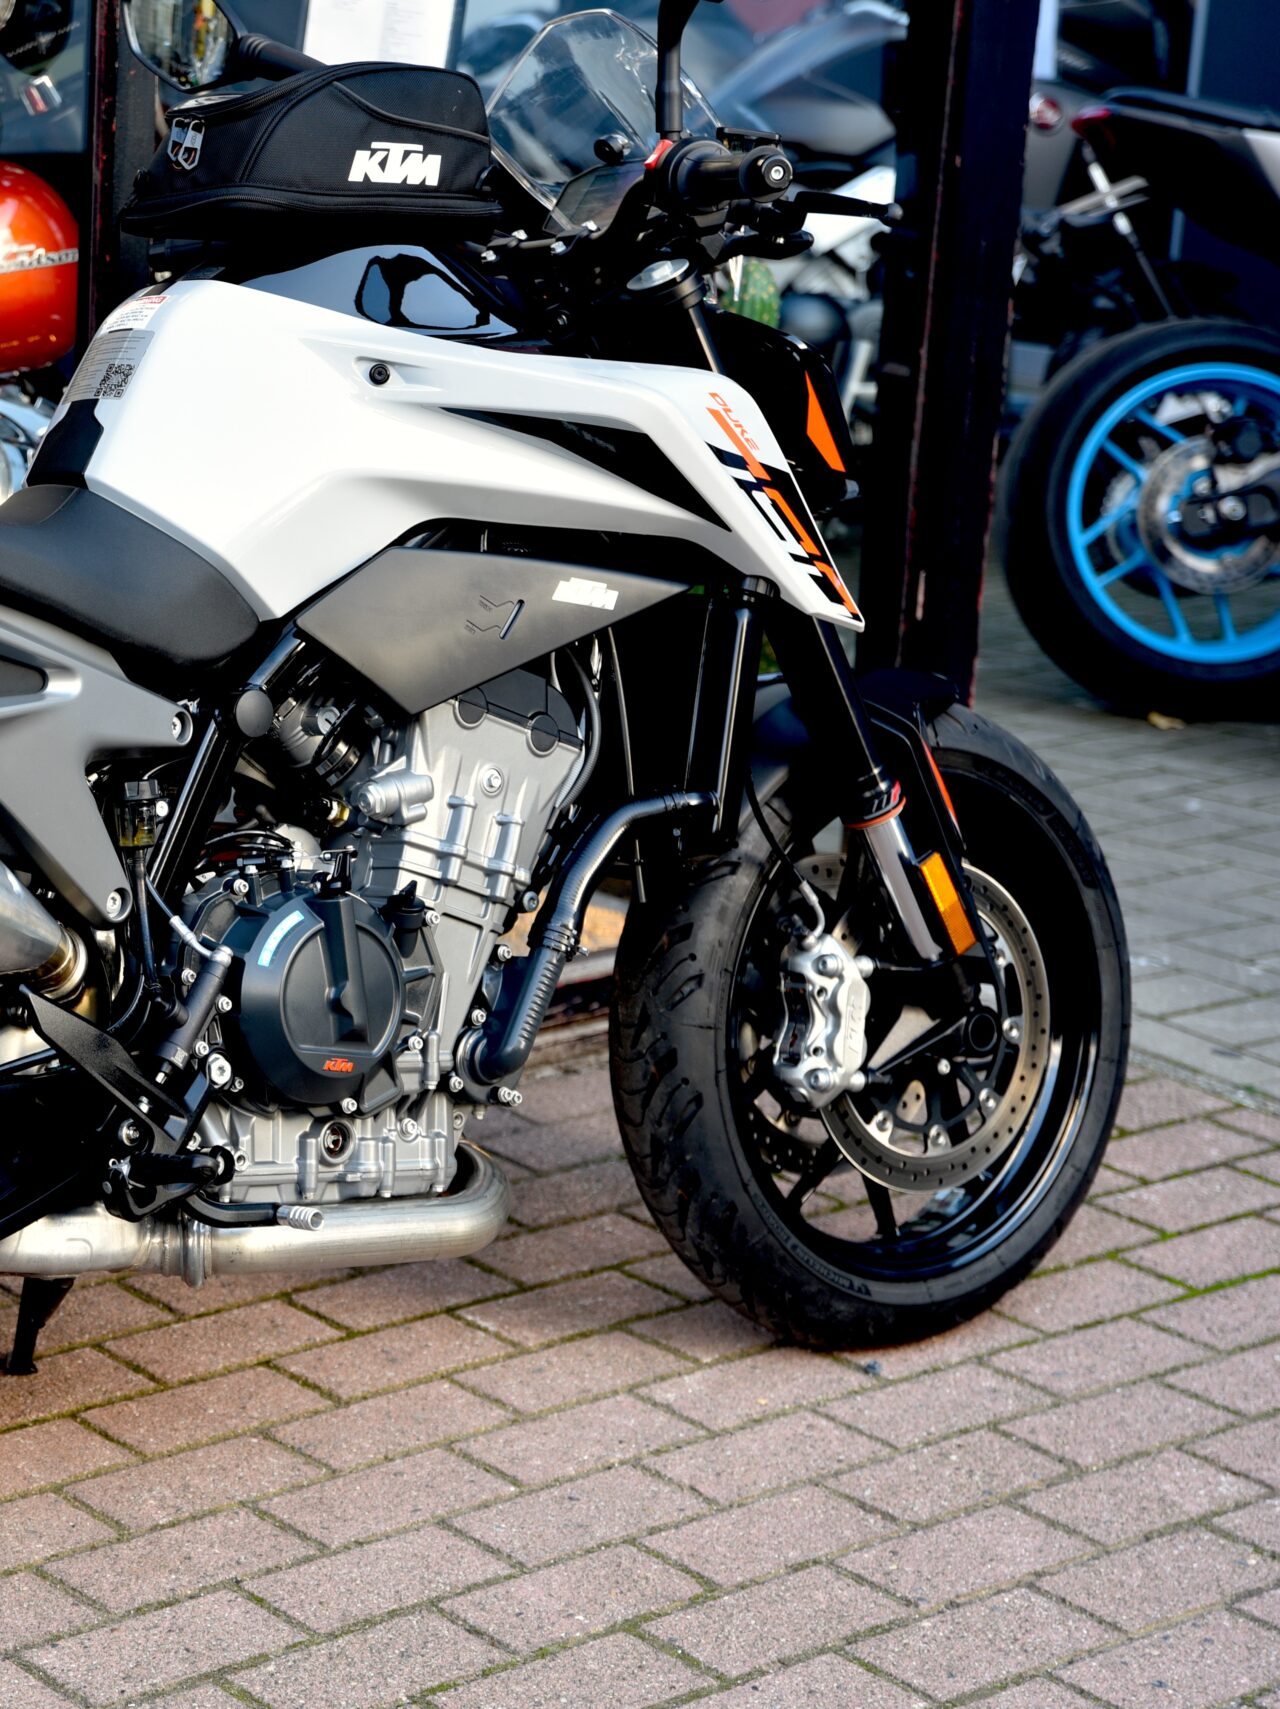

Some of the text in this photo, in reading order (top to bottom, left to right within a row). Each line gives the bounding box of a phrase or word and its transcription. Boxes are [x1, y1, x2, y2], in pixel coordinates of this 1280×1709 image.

[347, 141, 442, 187] KTM
[708, 392, 759, 451] DUKE
[323, 1057, 355, 1073] KTM
